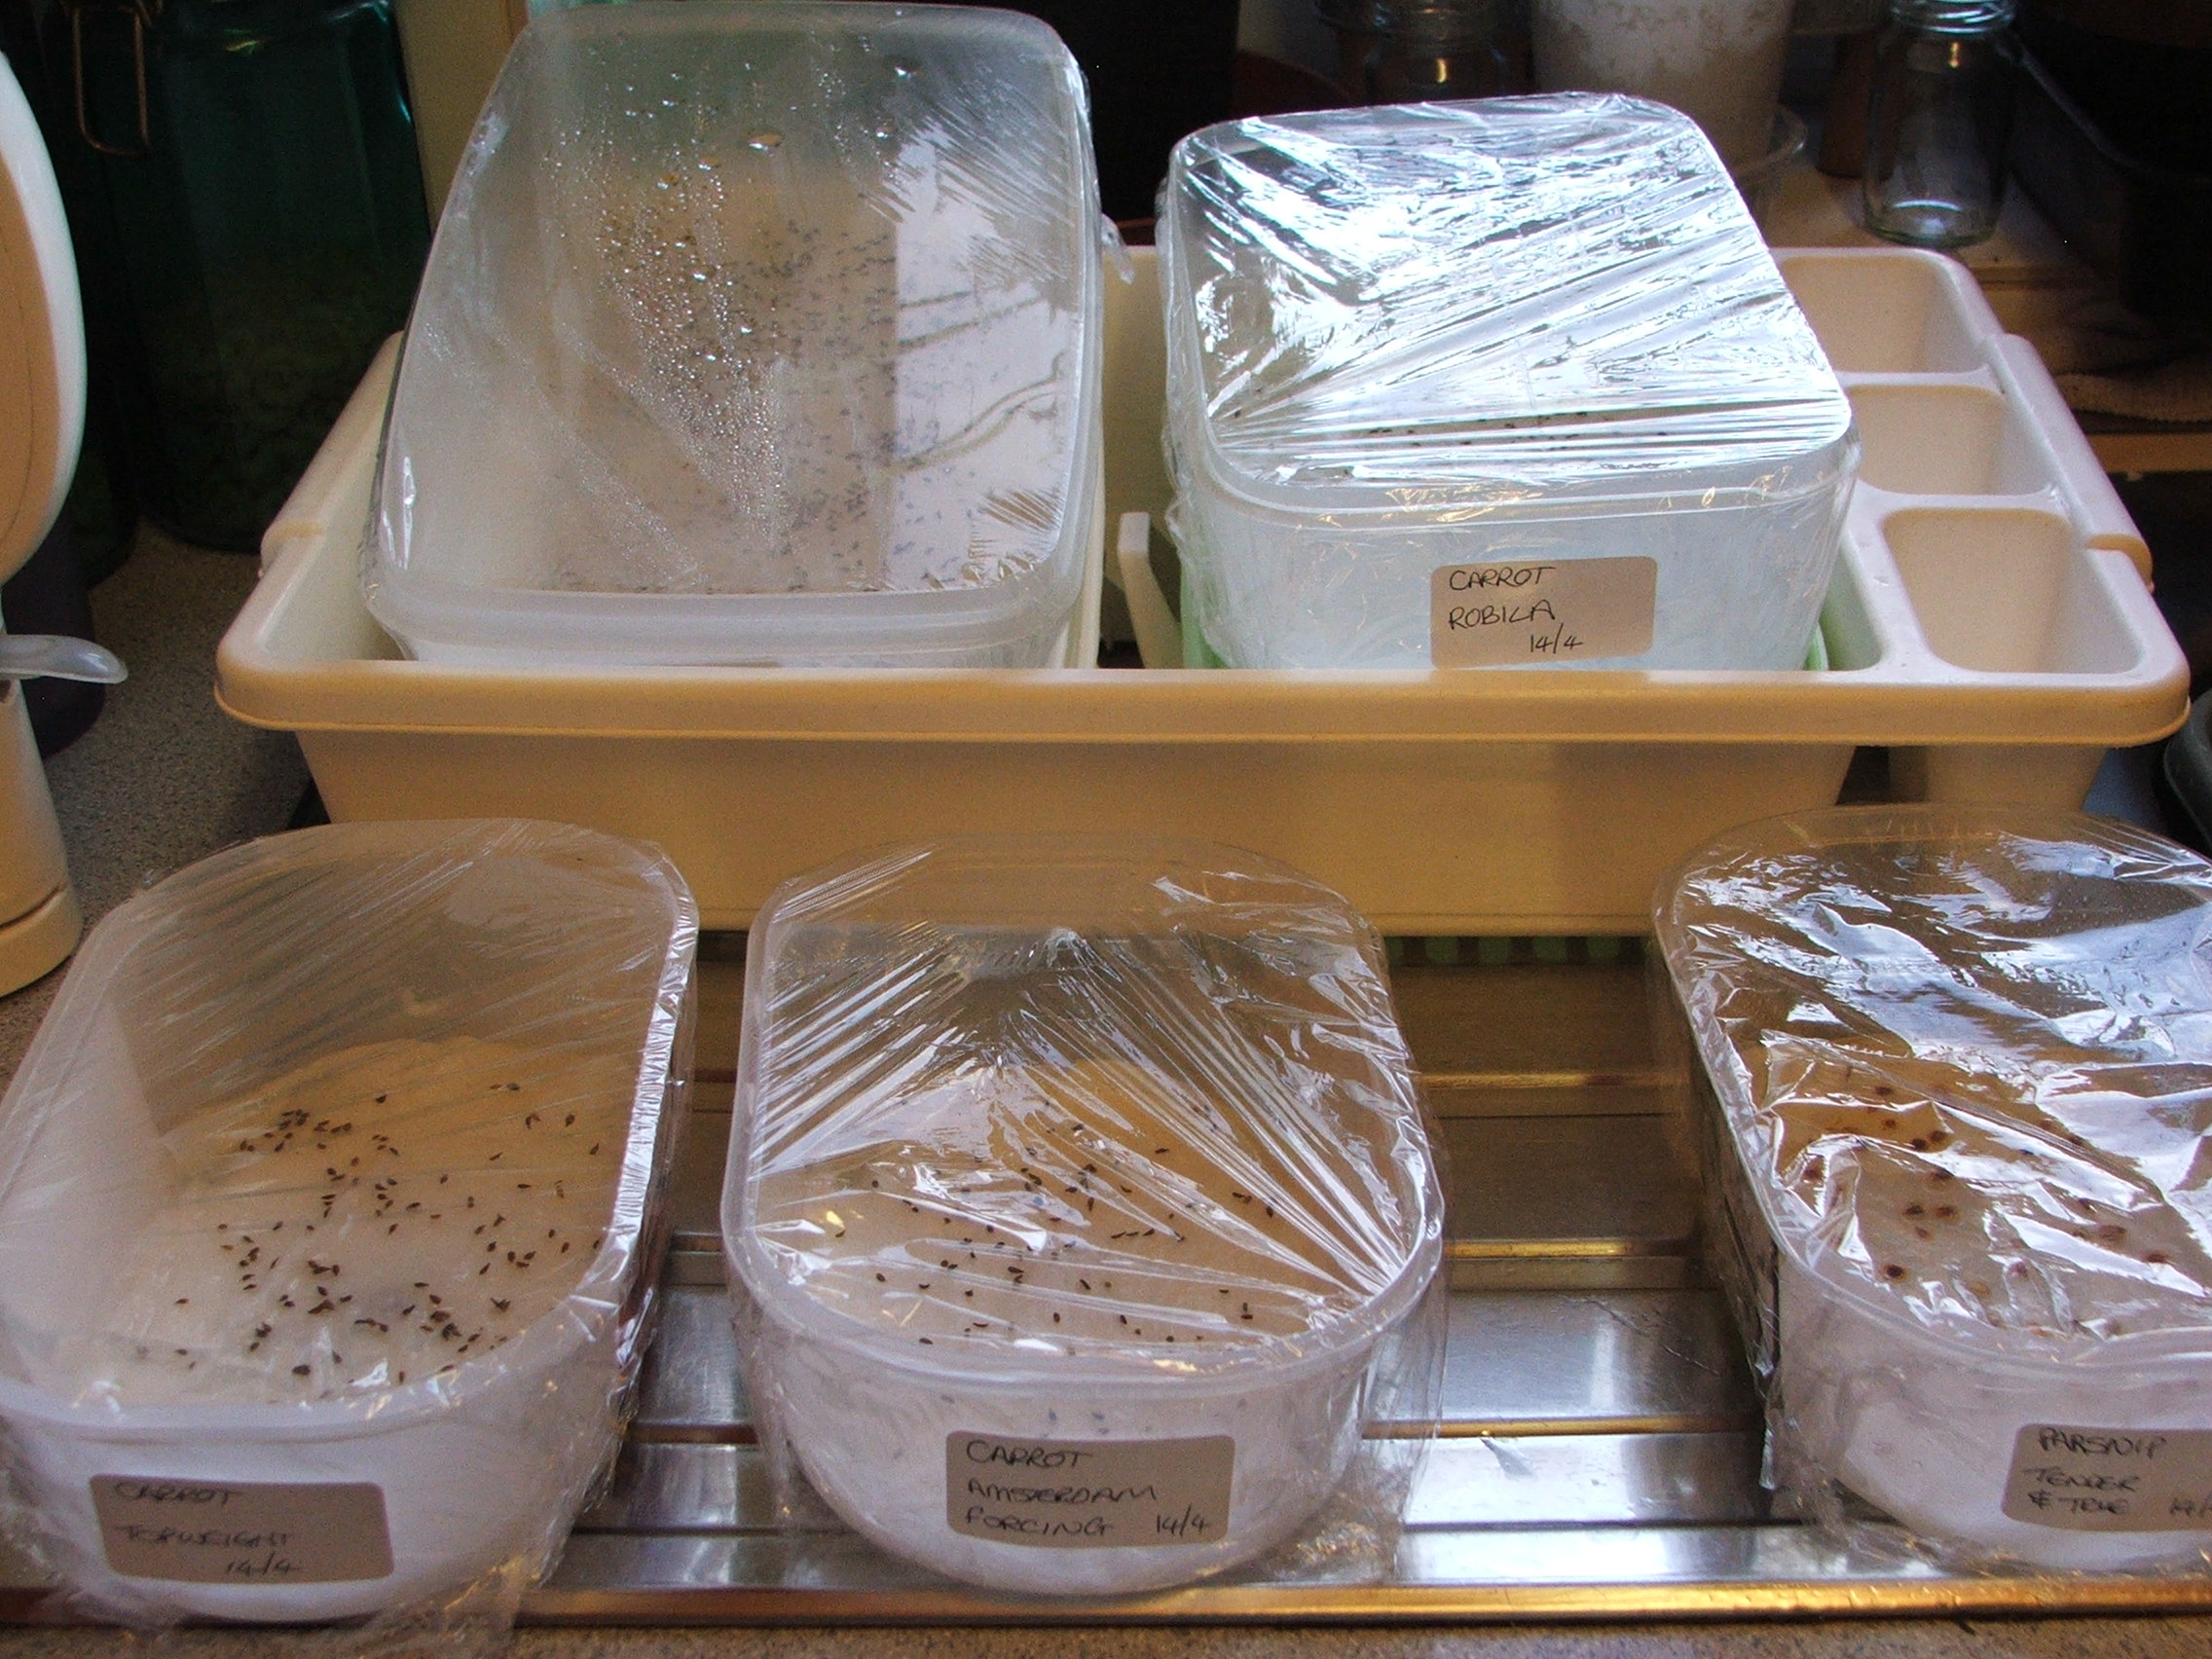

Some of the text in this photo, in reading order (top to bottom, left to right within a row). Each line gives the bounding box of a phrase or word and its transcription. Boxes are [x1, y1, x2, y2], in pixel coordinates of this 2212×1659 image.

[1449, 566, 1555, 591] CARROT
[1448, 599, 1556, 630] ROBILA
[1530, 622, 1584, 654] 14/4
[966, 1439, 1094, 1468] CARROT
[966, 1502, 1211, 1537] FORCING 14/4
[224, 1551, 300, 1575] 14/4
